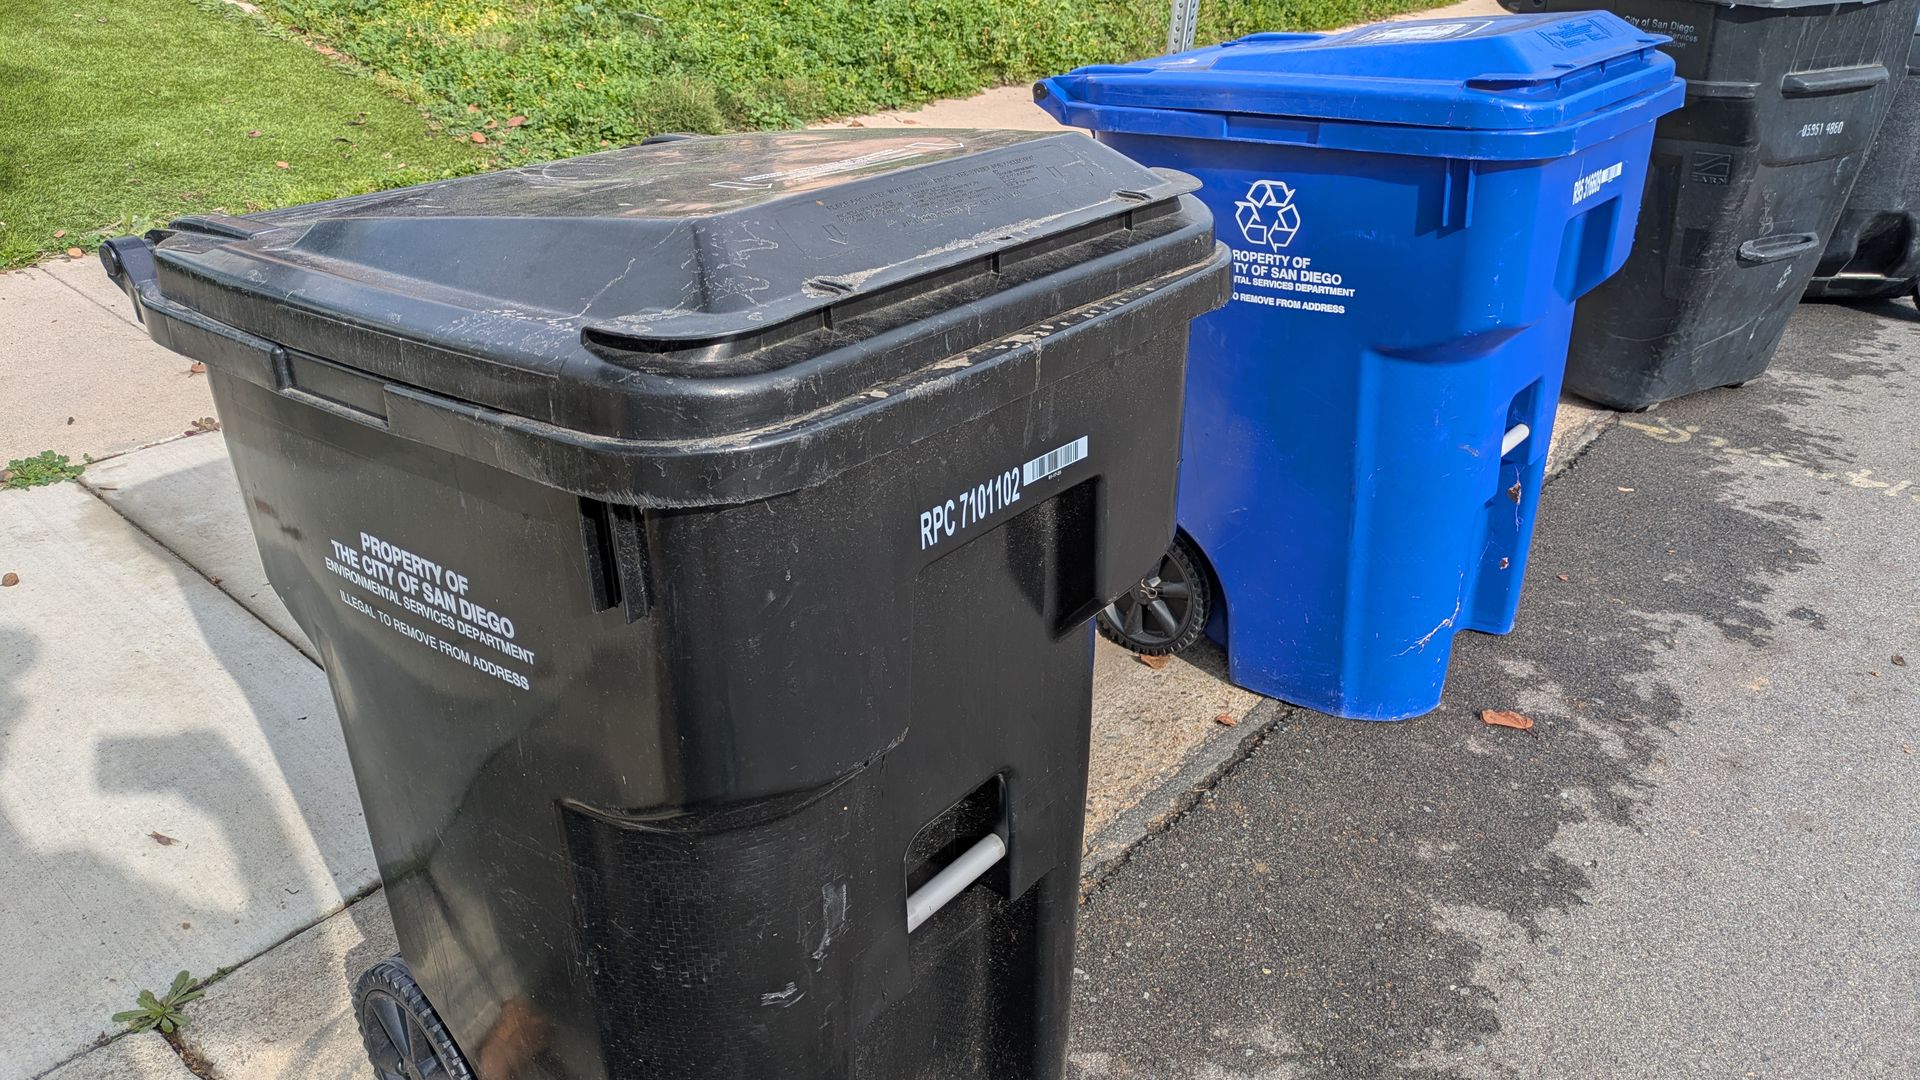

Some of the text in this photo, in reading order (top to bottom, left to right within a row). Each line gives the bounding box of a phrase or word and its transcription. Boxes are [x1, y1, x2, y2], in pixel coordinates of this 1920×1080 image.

[1642, 18, 1650, 27] of
[1652, 18, 1668, 29] San
[1671, 21, 1695, 34] Diego
[1232, 249, 1311, 269] ROPERTY OF
[1233, 262, 1342, 286] TY OF SAN DIEGO
[1240, 293, 1275, 306] REMOVE
[1275, 298, 1301, 309] FROM
[1301, 301, 1345, 314] ADDRESS
[1252, 277, 1294, 291] SERVICES
[1295, 283, 1356, 298] DEPARTMENT
[920, 466, 1021, 551] RPC 7101102
[360, 531, 469, 597] PROPERTY OF
[324, 556, 535, 666] ENVIRONMENTAL SERVICES DEPARTMENT
[330, 539, 516, 640] THE CITY OF SAN DIEGO
[339, 589, 530, 691] ILLEGAL TO REMOVE FROM ADDRESS
